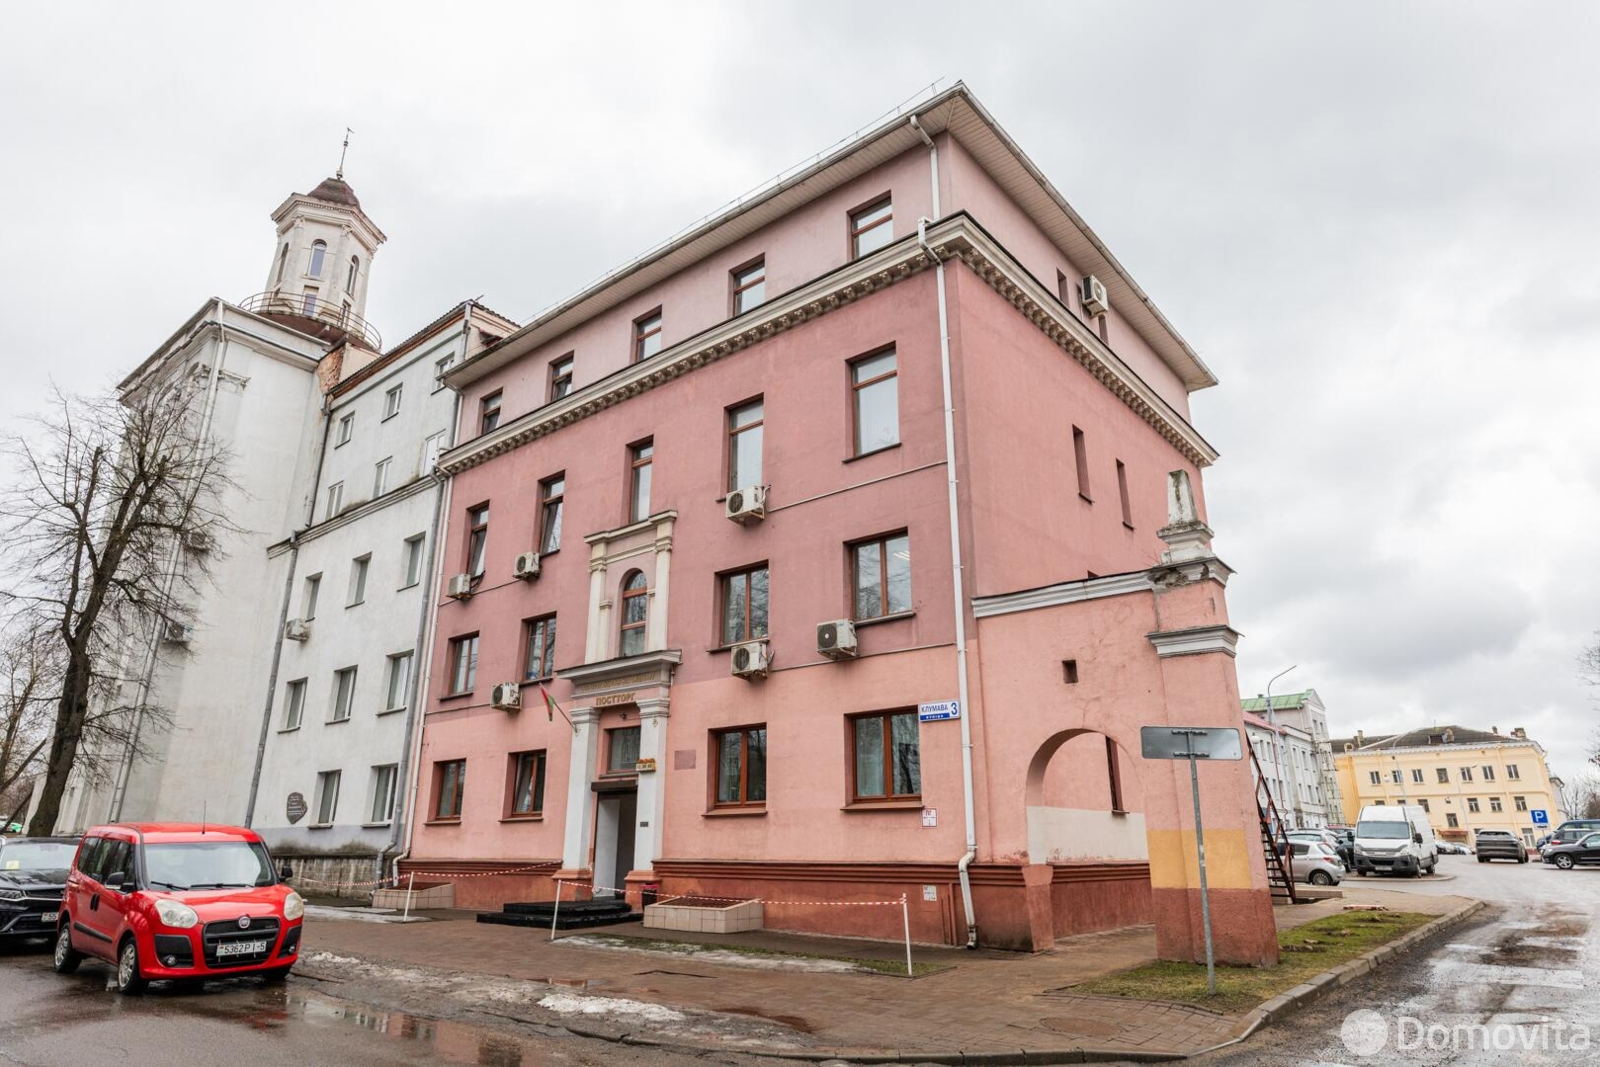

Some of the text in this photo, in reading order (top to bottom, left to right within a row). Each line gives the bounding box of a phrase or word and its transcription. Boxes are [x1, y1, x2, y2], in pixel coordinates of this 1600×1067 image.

[596, 692, 635, 706] ПОСТТОРГ
[921, 702, 957, 715] КЛУМАВА 3
[1534, 811, 1544, 822] P
